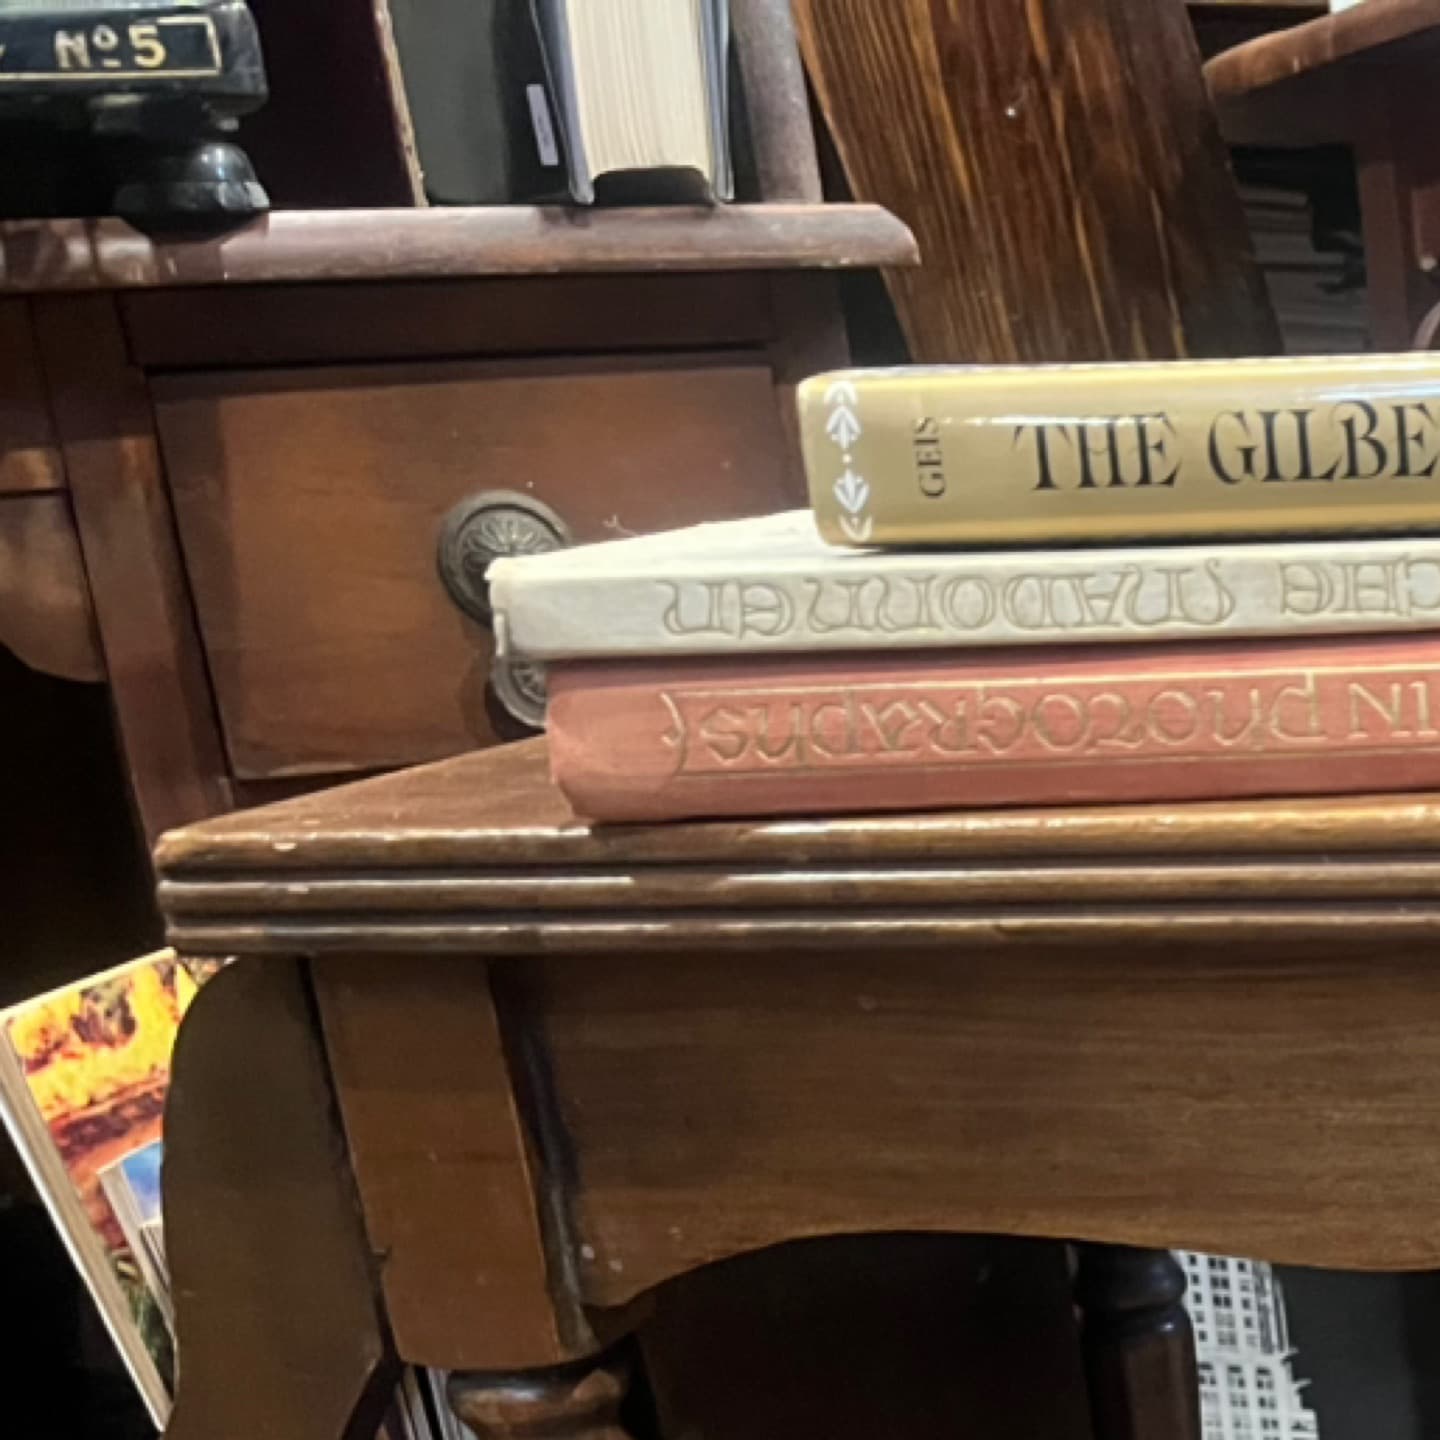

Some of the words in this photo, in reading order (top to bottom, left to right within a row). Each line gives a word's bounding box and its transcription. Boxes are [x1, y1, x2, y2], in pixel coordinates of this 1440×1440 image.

[913, 416, 945, 500] GEIS
[1015, 410, 1182, 492] THE
[1346, 682, 1438, 742] IN
